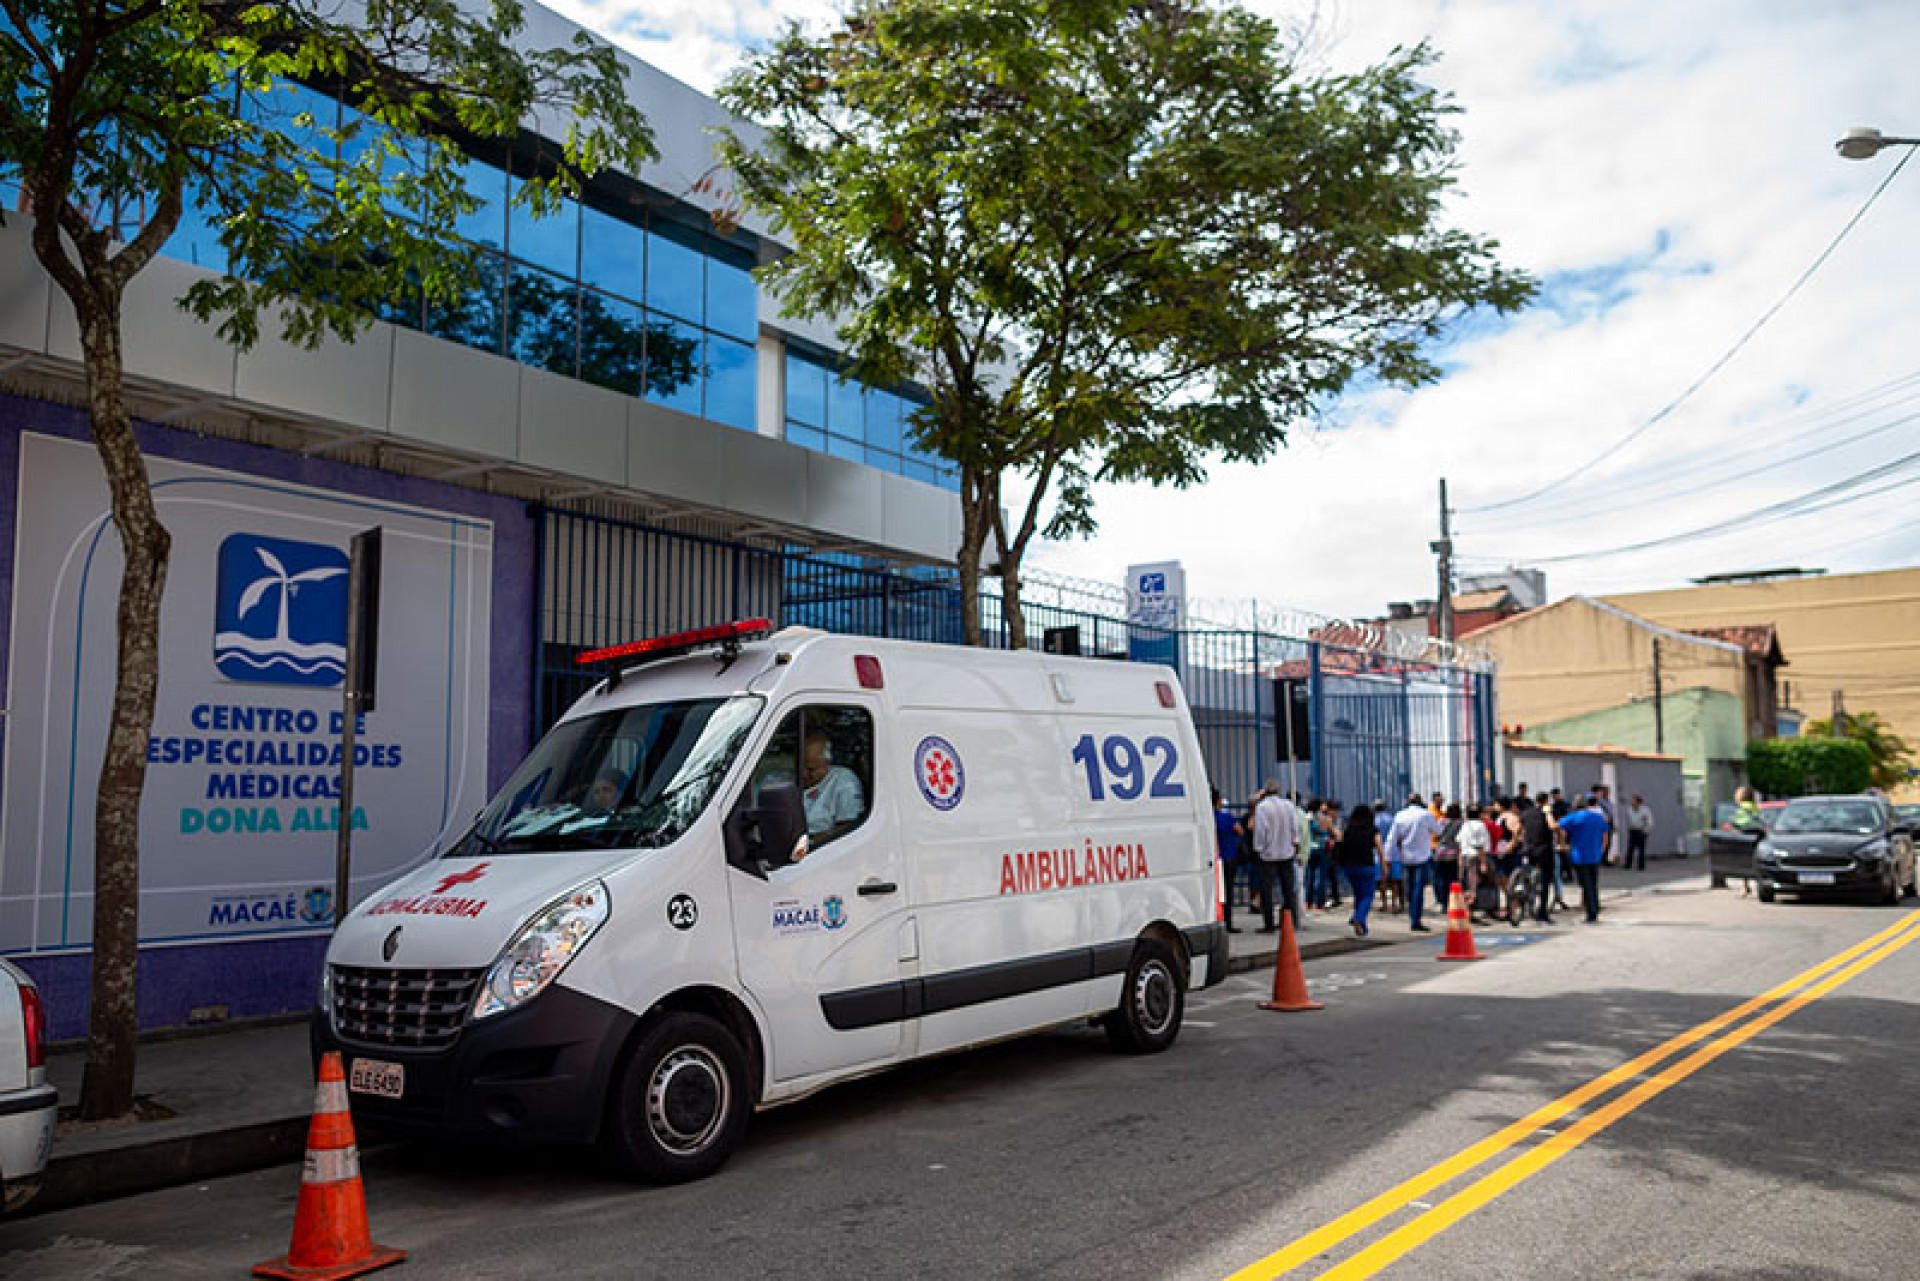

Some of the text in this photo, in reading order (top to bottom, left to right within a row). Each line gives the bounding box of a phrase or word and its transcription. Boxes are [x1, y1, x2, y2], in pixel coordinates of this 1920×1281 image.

[191, 704, 367, 736] CENTRO DE
[146, 735, 403, 769] ESPECIALIDADES
[1072, 733, 1186, 801] 192
[179, 806, 283, 834] DONA
[999, 836, 1150, 896] AMBULÂNCIA
[209, 891, 298, 925] MACAÉ
[671, 900, 695, 924] 23
[772, 904, 820, 928] MACAÉ
